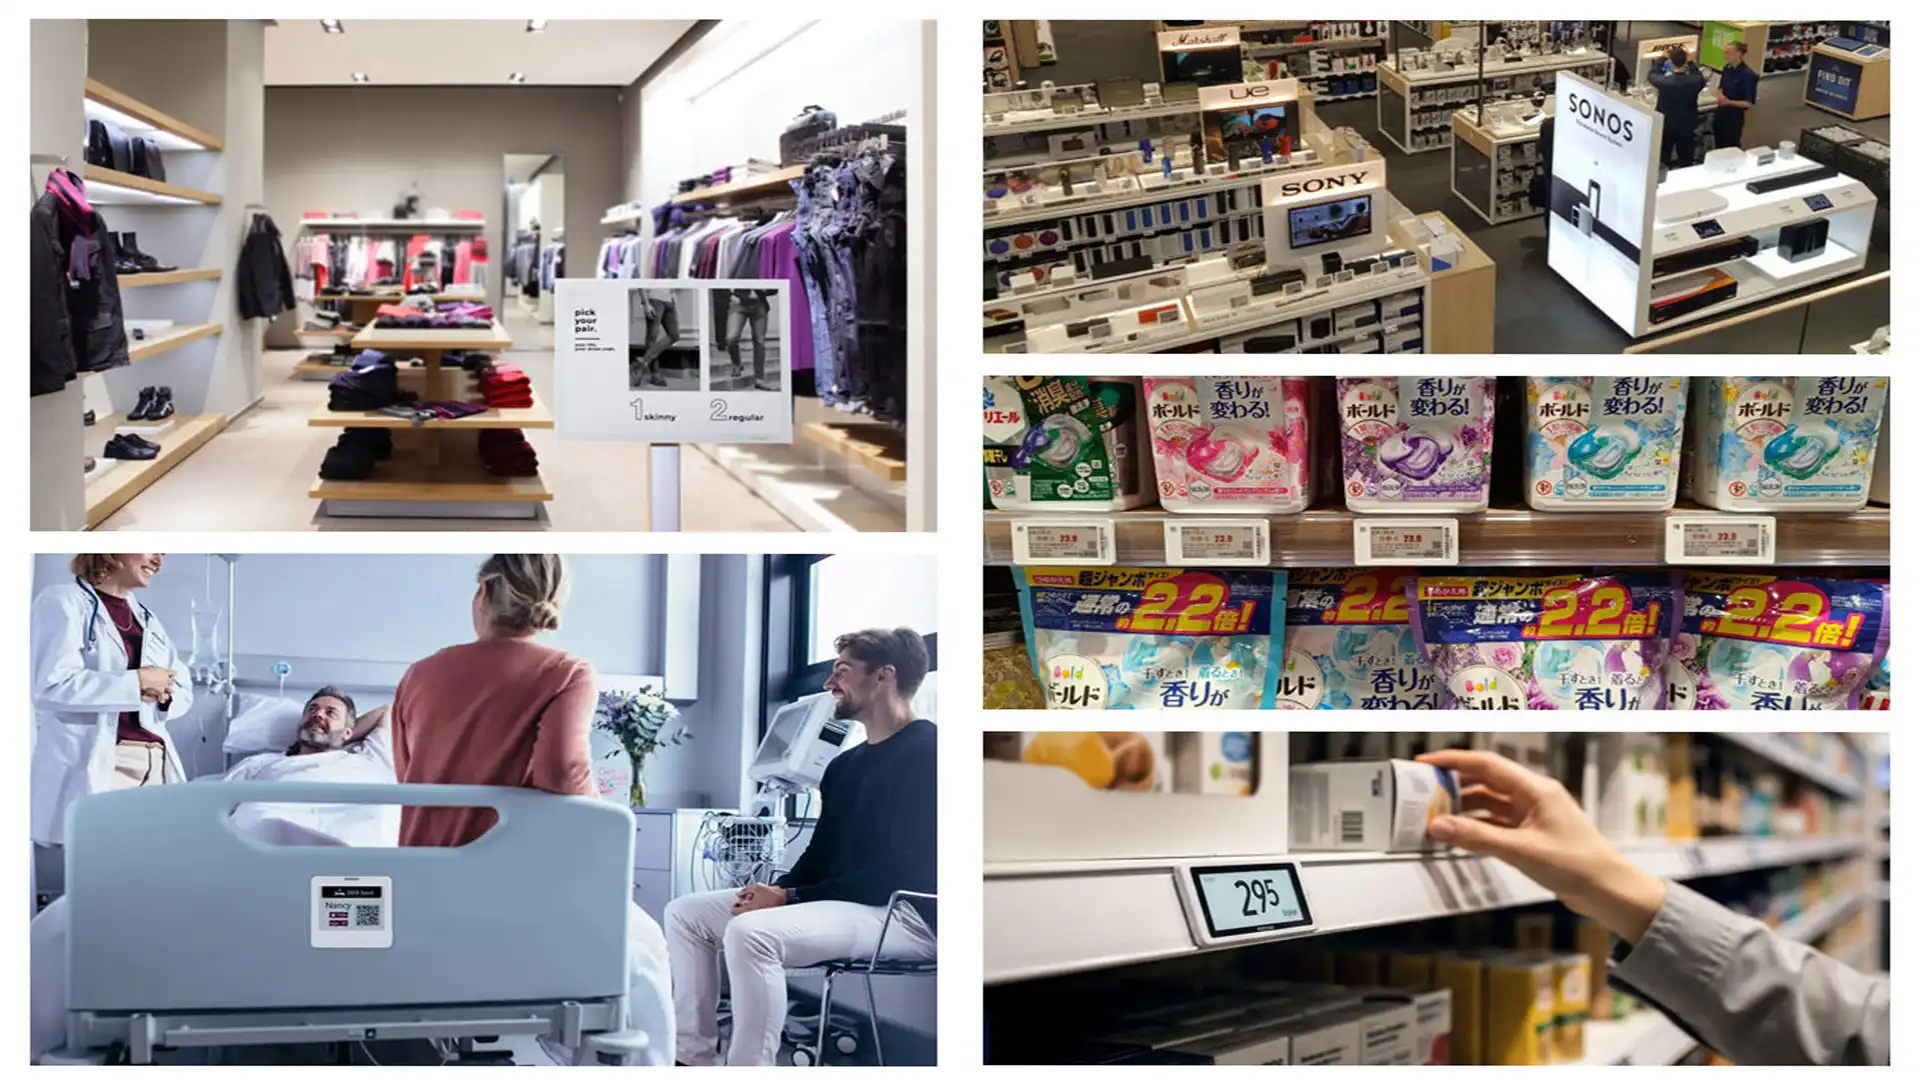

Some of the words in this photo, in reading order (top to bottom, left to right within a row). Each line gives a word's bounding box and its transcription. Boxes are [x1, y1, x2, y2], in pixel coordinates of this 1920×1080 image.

[1171, 32, 1228, 46] Marshall
[1568, 92, 1634, 142] SONOS
[1281, 171, 1369, 196] SONY
[574, 308, 597, 317] pick
[574, 324, 599, 334] pair.
[1214, 381, 1265, 400] 香りが
[1416, 377, 1467, 397] 香りが
[1612, 376, 1664, 396] 香りが
[1817, 376, 1869, 396] 香りが
[629, 397, 643, 421] 1
[643, 412, 677, 422] skinny
[709, 397, 728, 421] 2
[728, 413, 765, 423] regular
[1152, 403, 1201, 419] ボールド
[1346, 403, 1397, 419] ボールド
[1539, 402, 1591, 418] ボールド
[1738, 401, 1792, 418] ボールド
[1071, 593, 1132, 616] 通常の
[1371, 667, 1437, 694] 香りが
[1160, 680, 1231, 708] 香りが
[324, 901, 352, 911] Nancy
[1234, 879, 1280, 917] 295
